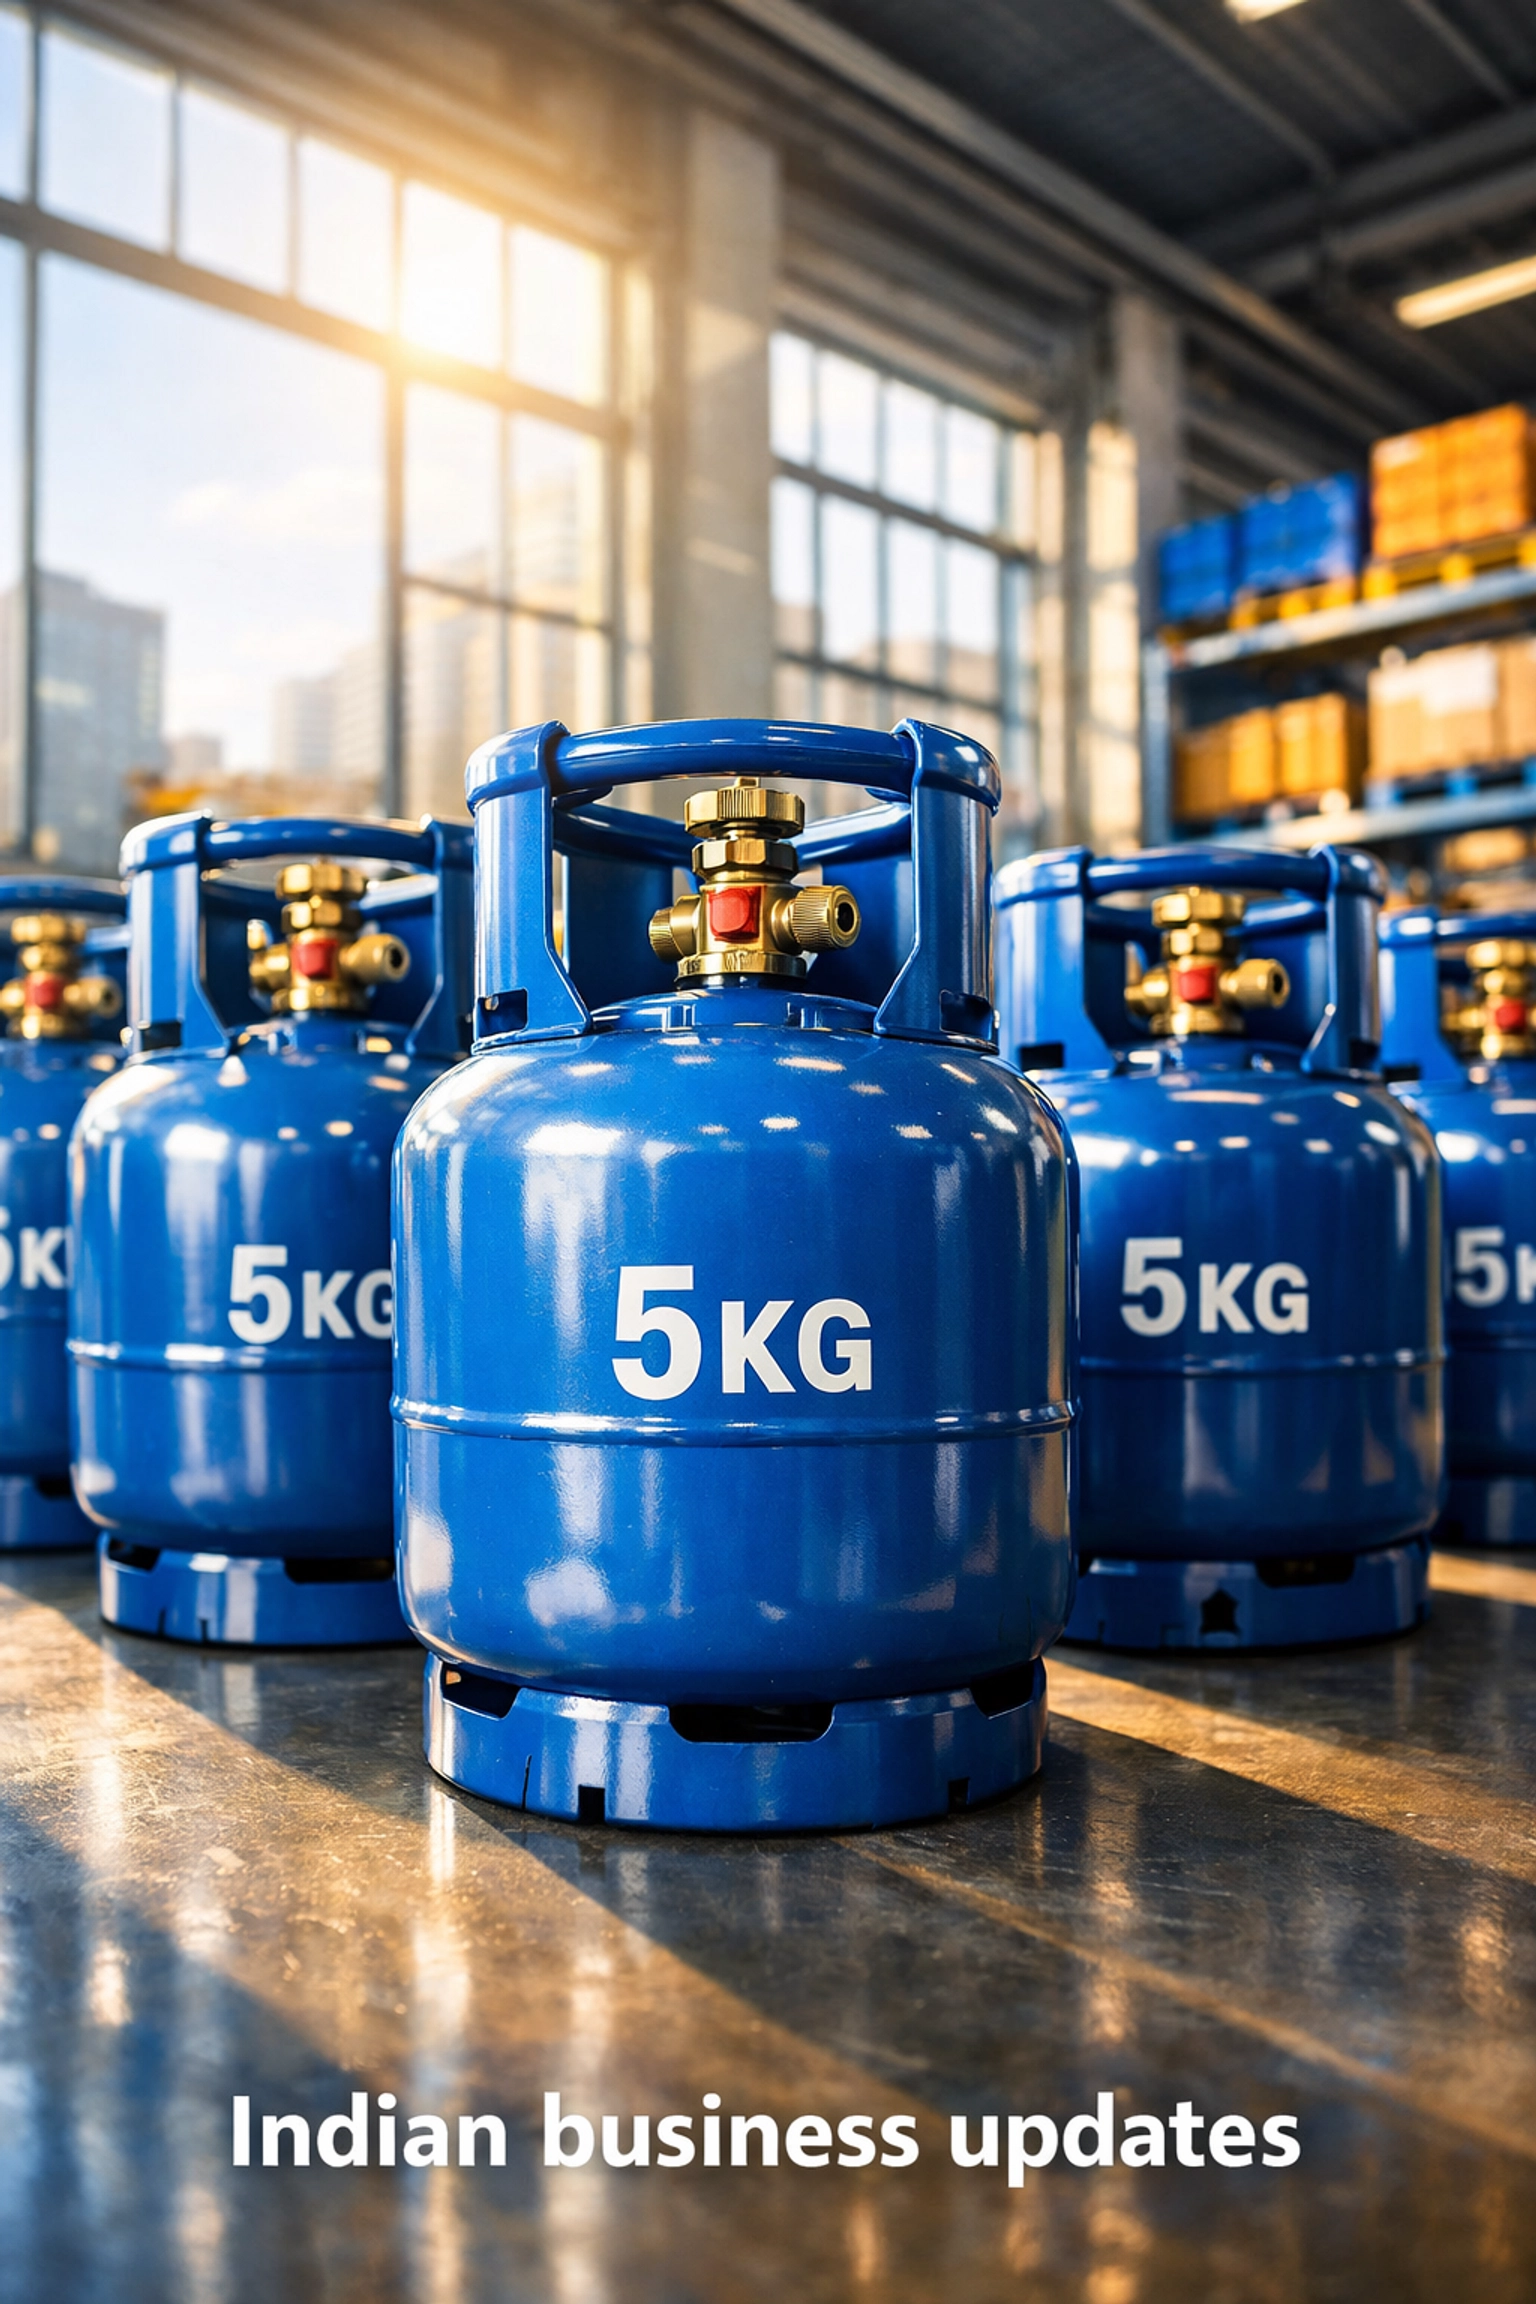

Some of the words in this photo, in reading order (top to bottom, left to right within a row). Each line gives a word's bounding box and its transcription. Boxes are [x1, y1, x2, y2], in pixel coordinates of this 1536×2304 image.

[20, 1227, 66, 1290] K
[228, 1244, 292, 1344] 5
[1120, 1236, 1187, 1336] 5
[1198, 1262, 1309, 1334] KG
[1456, 1226, 1509, 1307] 5
[611, 1264, 702, 1401] 5
[721, 1298, 872, 1394] KG
